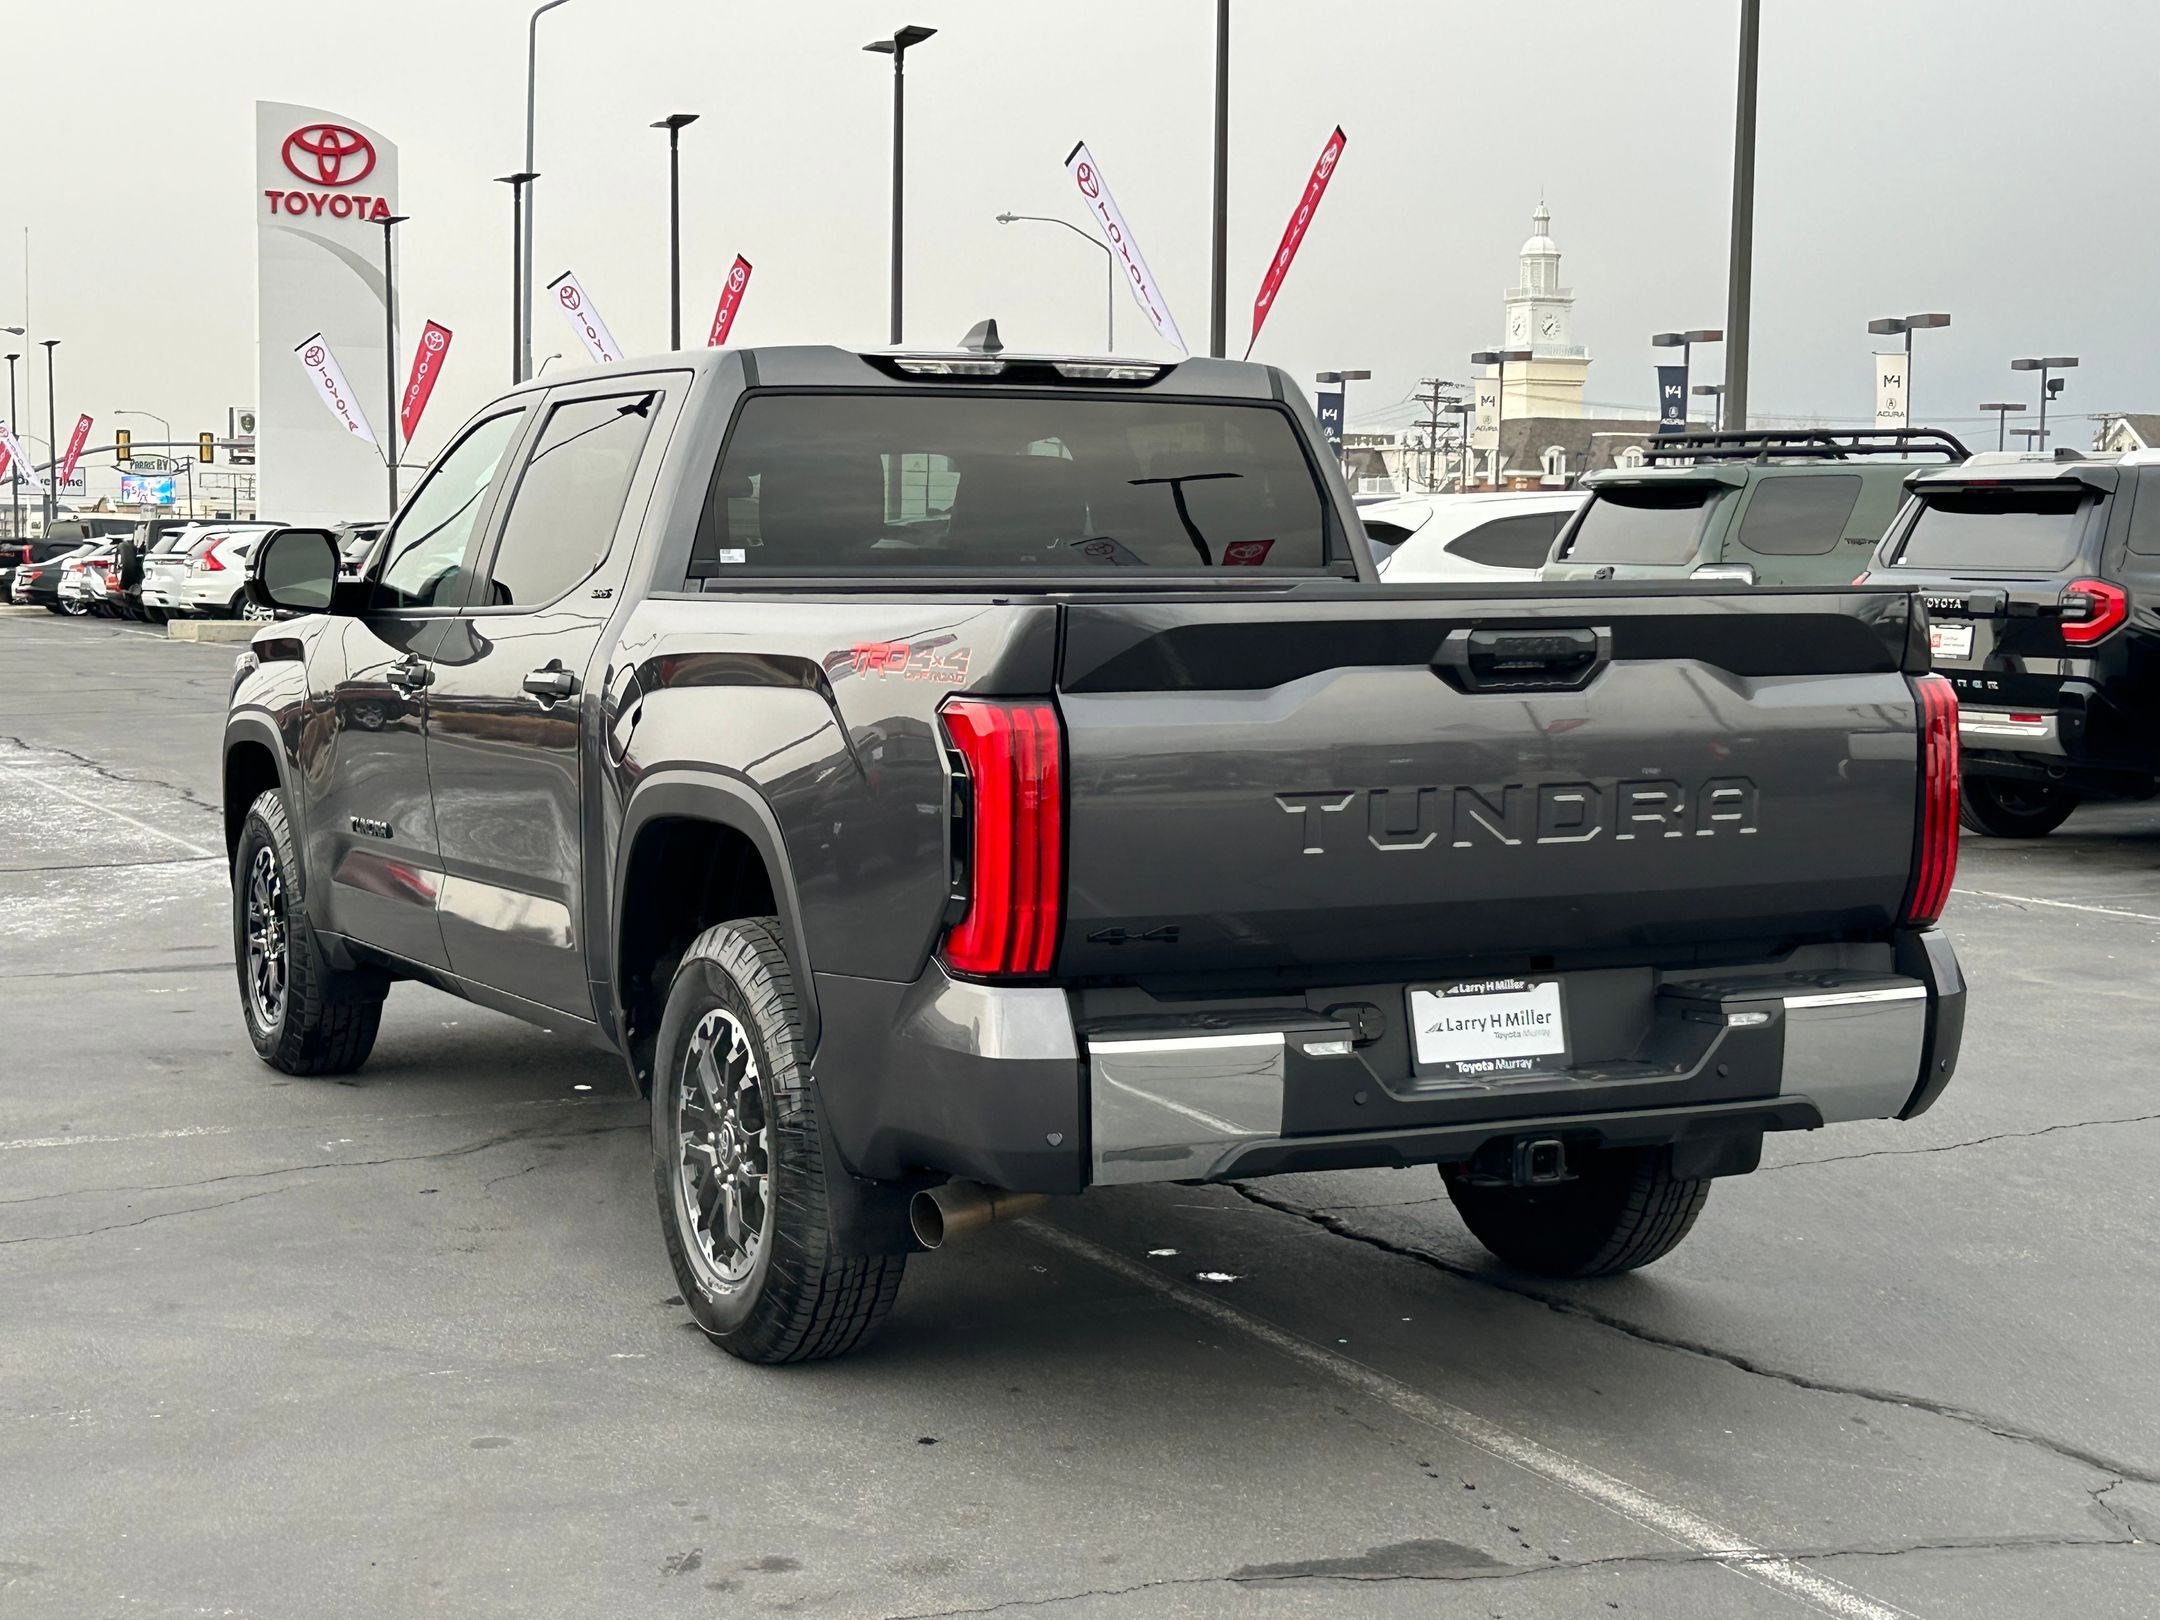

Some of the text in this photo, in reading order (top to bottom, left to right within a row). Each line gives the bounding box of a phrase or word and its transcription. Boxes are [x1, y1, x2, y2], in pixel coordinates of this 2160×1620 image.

[265, 190, 392, 220] TOYOTA
[401, 351, 434, 418] TOYOTA
[319, 366, 359, 432] TOYOTA
[1876, 410, 1905, 418] ACURA
[156, 458, 169, 471] RV
[851, 642, 911, 682] TRD
[1274, 775, 1759, 855] TUNDRA
[1459, 978, 1526, 994] Larry H Miller
[1446, 1009, 1552, 1033] Larry H Miller
[1494, 1031, 1521, 1041] Toyota
[1456, 1058, 1533, 1074] Toyota Murray
